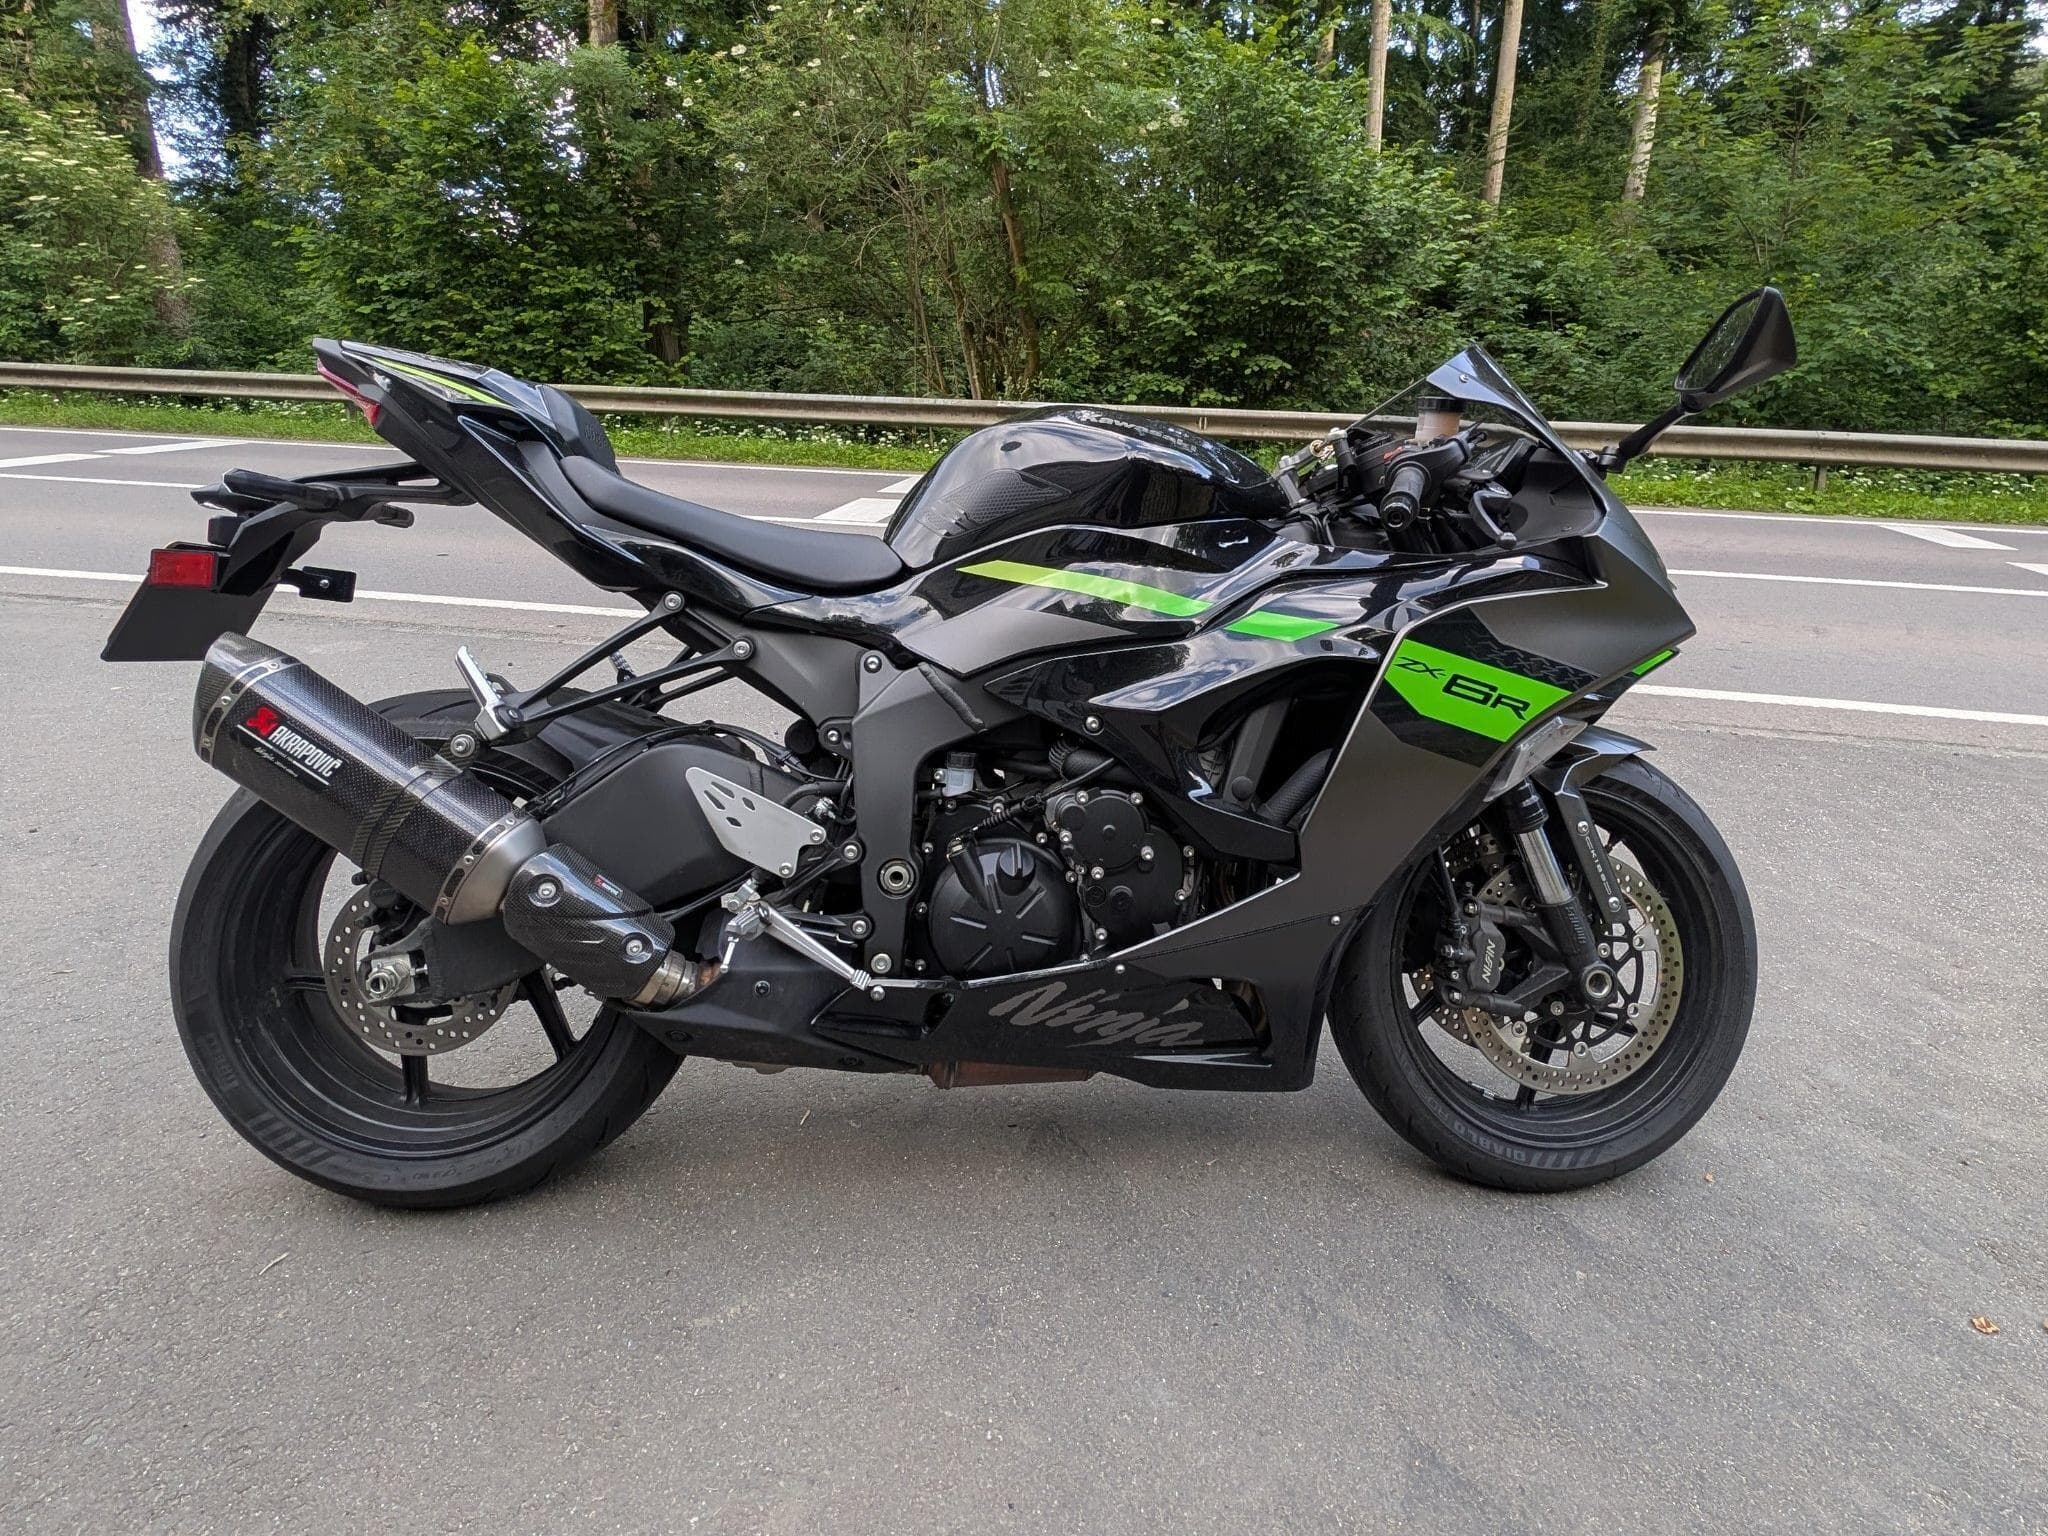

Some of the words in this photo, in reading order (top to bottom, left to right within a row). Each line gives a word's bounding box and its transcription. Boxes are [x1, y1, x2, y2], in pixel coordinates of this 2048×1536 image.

[1394, 656, 1530, 720] ZX-6R
[988, 981, 1204, 1048] Ninja
[1453, 1120, 1527, 1162] DIABLO
